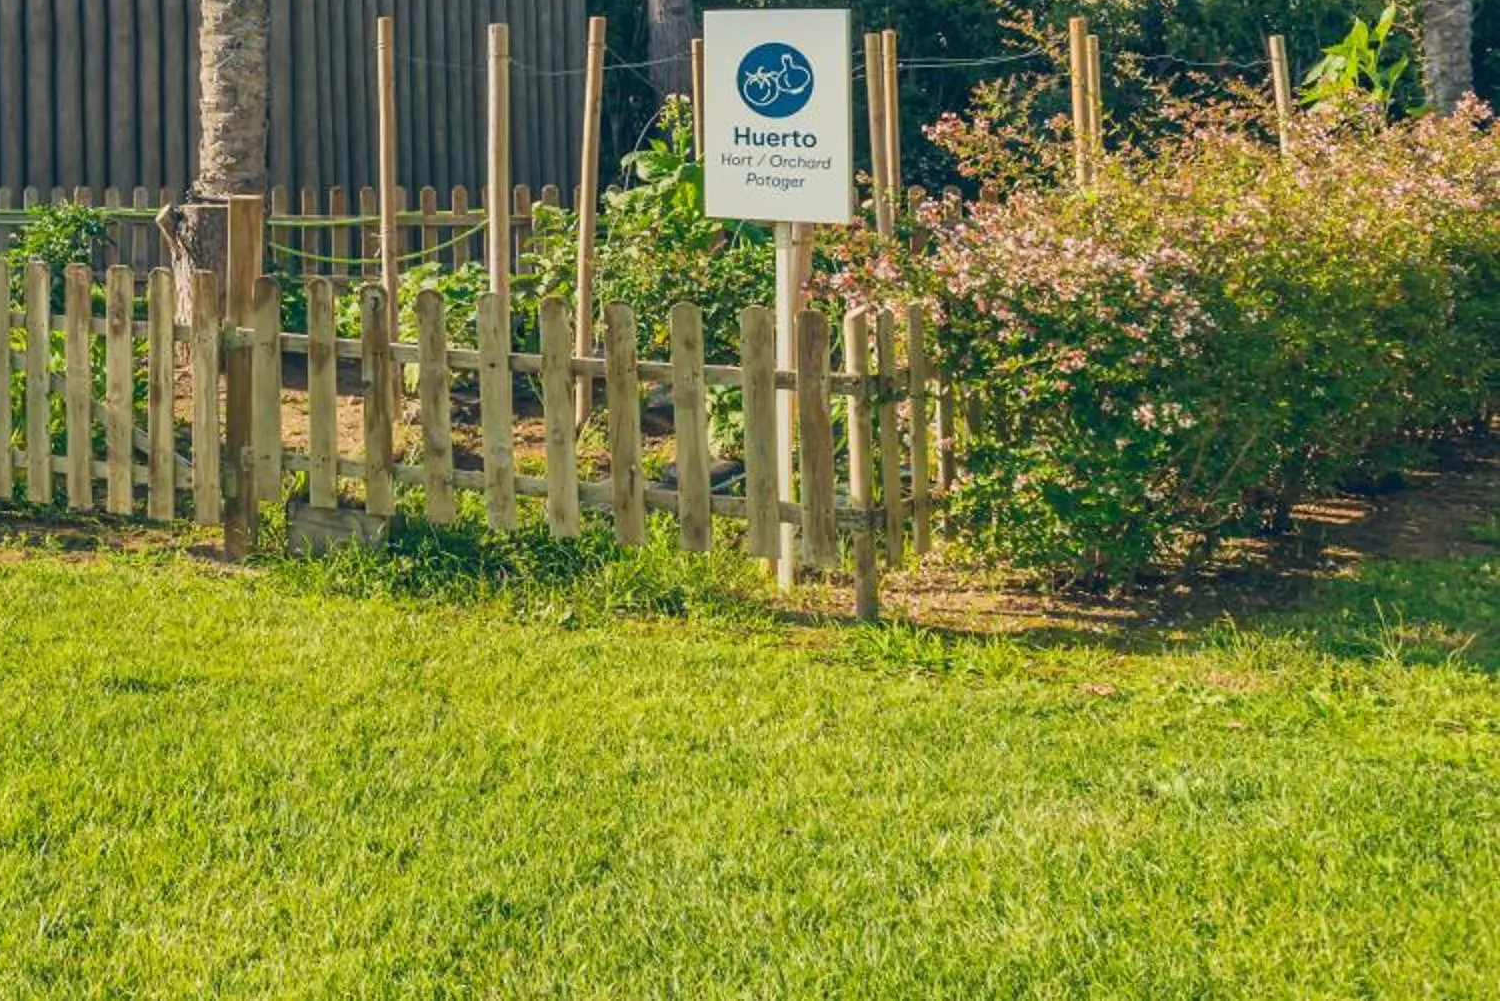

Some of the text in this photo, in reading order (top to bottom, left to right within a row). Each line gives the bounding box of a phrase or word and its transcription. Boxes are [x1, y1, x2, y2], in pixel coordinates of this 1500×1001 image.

[734, 126, 817, 148] Huerto
[721, 153, 832, 170] Hort / Orchard
[746, 172, 805, 191] Potager
